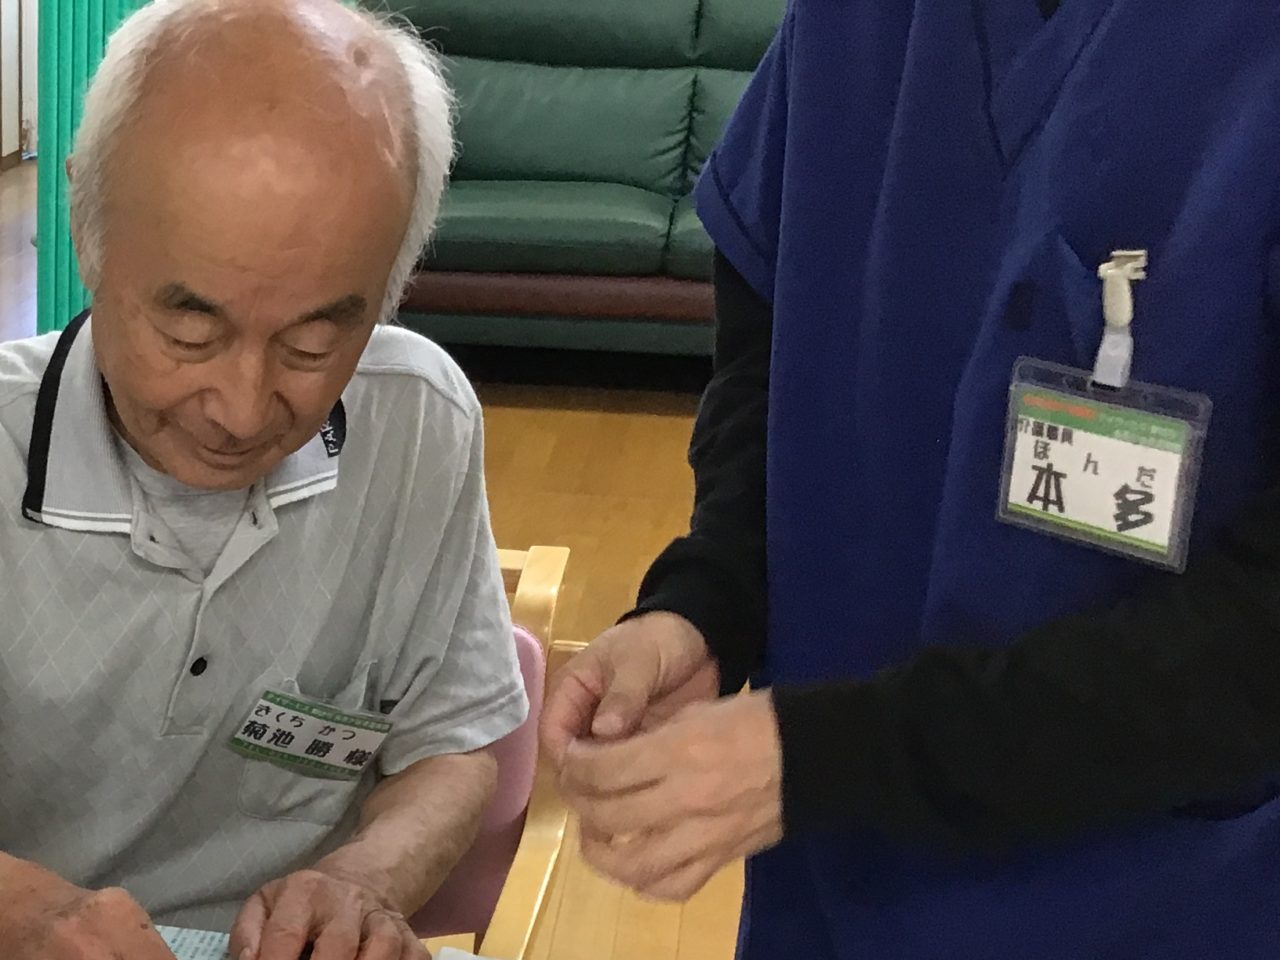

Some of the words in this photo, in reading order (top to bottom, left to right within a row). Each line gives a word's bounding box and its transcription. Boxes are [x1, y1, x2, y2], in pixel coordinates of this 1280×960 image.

[1026, 462, 1156, 533] 本多
[253, 703, 306, 729] きくち
[241, 718, 296, 749] 菊池
[304, 738, 335, 759] 勝
